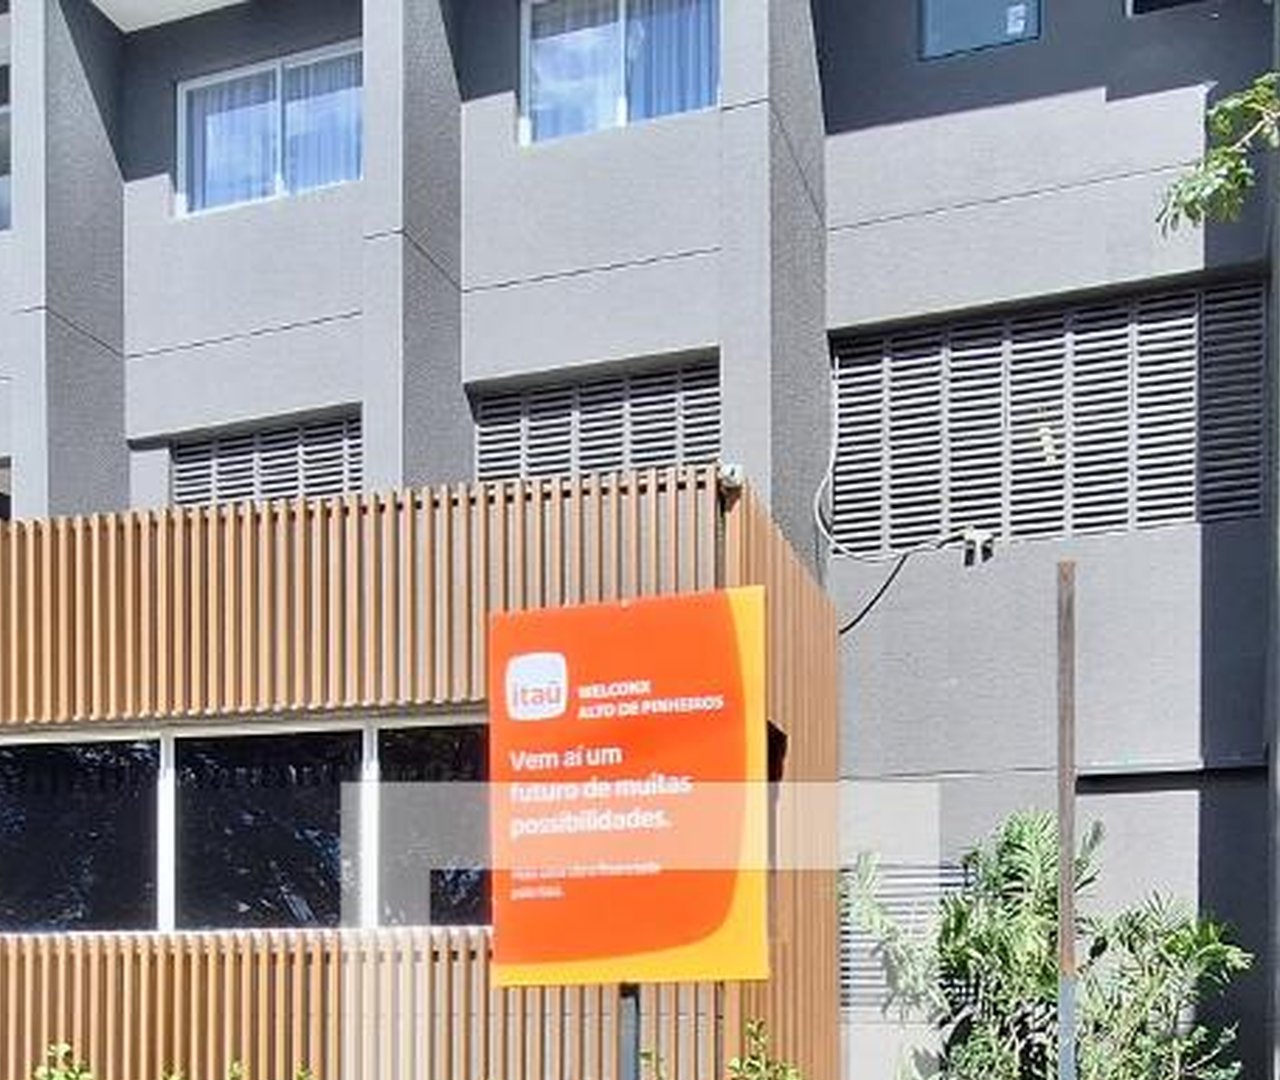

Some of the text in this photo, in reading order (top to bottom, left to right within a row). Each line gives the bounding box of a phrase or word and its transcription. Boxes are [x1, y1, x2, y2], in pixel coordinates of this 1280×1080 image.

[513, 680, 562, 708] itaú
[578, 680, 652, 699] WELCONX
[577, 694, 725, 720] ALTO DE PINHEIROS
[510, 745, 622, 770] Vem aí um
[510, 771, 693, 802] futuro de muitas
[510, 807, 671, 839] possibilidades.
